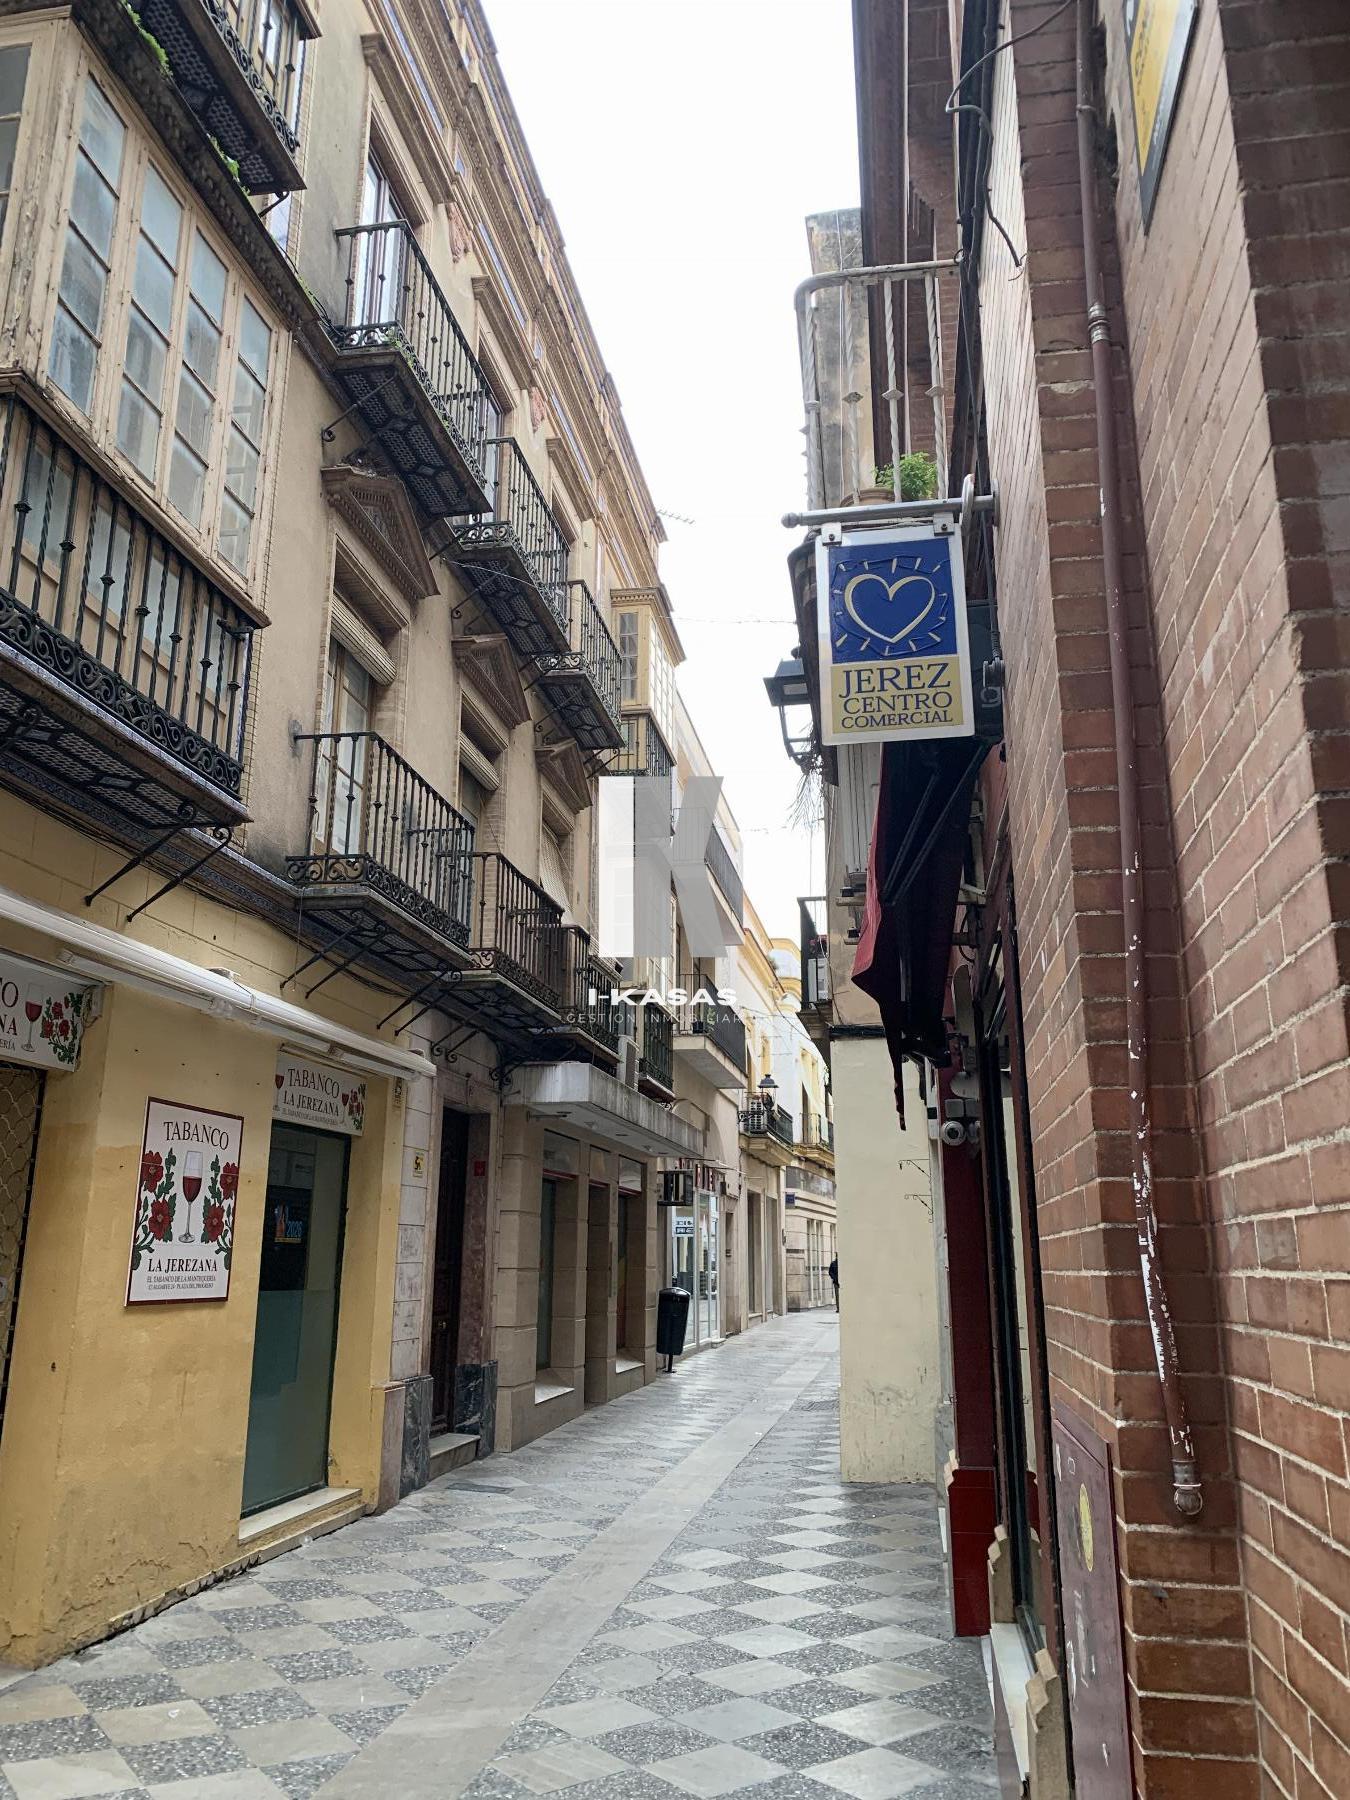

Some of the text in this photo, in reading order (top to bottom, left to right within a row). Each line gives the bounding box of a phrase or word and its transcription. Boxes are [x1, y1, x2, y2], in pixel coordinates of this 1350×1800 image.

[839, 662, 952, 699] JEREZ
[843, 691, 953, 715] CENTRO
[841, 709, 954, 729] COMERCIAL
[0, 977, 19, 1008] O
[287, 1068, 340, 1099] TABANCO
[283, 1090, 295, 1107] LA
[296, 1094, 339, 1117] JEREZANA
[163, 1121, 229, 1151] TABANCO
[147, 1258, 218, 1274] LA JEREZANA
